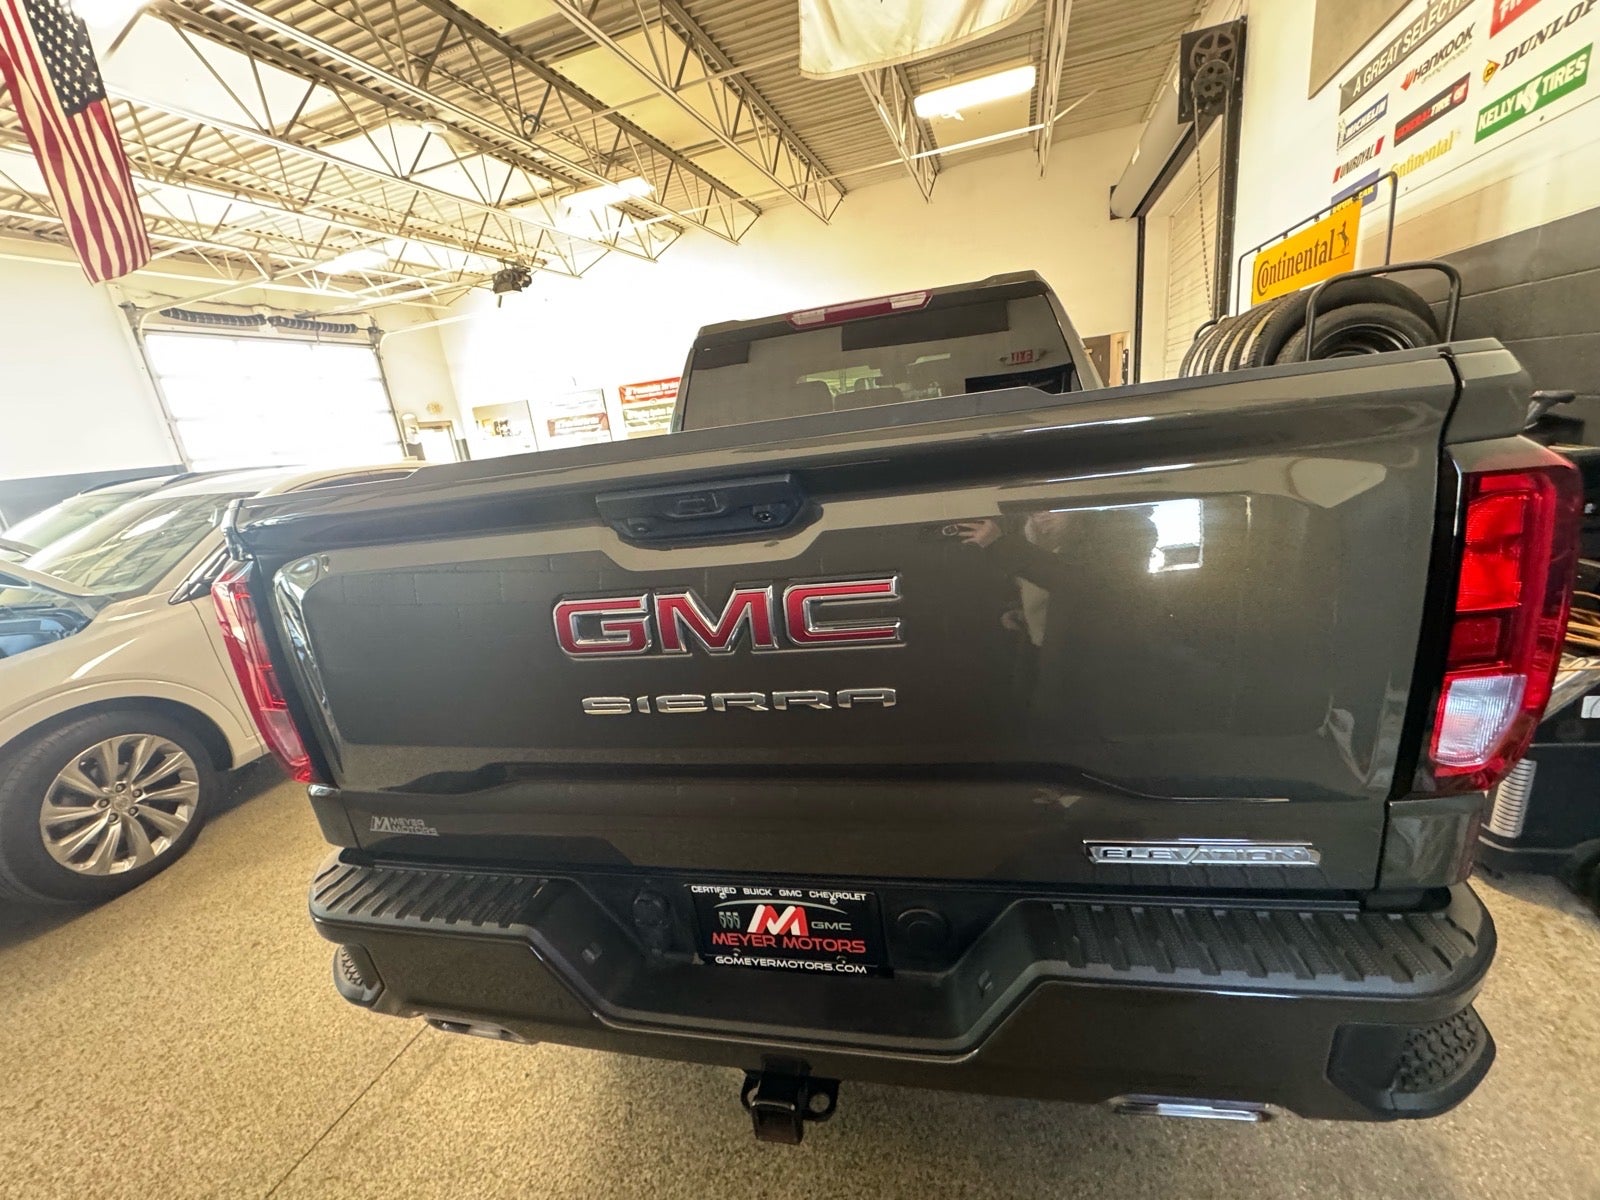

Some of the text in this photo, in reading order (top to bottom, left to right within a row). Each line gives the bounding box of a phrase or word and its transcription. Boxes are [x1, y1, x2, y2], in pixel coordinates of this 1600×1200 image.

[1352, 76, 1361, 98] A
[1362, 39, 1402, 88] GREAT
[1478, 94, 1517, 132] KELLY
[1541, 53, 1588, 97] TIRES
[1345, 98, 1388, 140] MICHELIN
[1340, 143, 1376, 179] UNIROYAL
[1256, 228, 1336, 297] Continental
[552, 576, 903, 657] GMC
[581, 687, 898, 715] SIERRA
[1095, 845, 1312, 863] ELEVATION
[691, 885, 867, 901] CERTIFIED BUICK GMC CHEVROLET
[711, 931, 867, 954] MEYER MOTORS
[811, 921, 852, 932] GMC
[715, 955, 868, 975] GOMEYERMOTORS.COM
